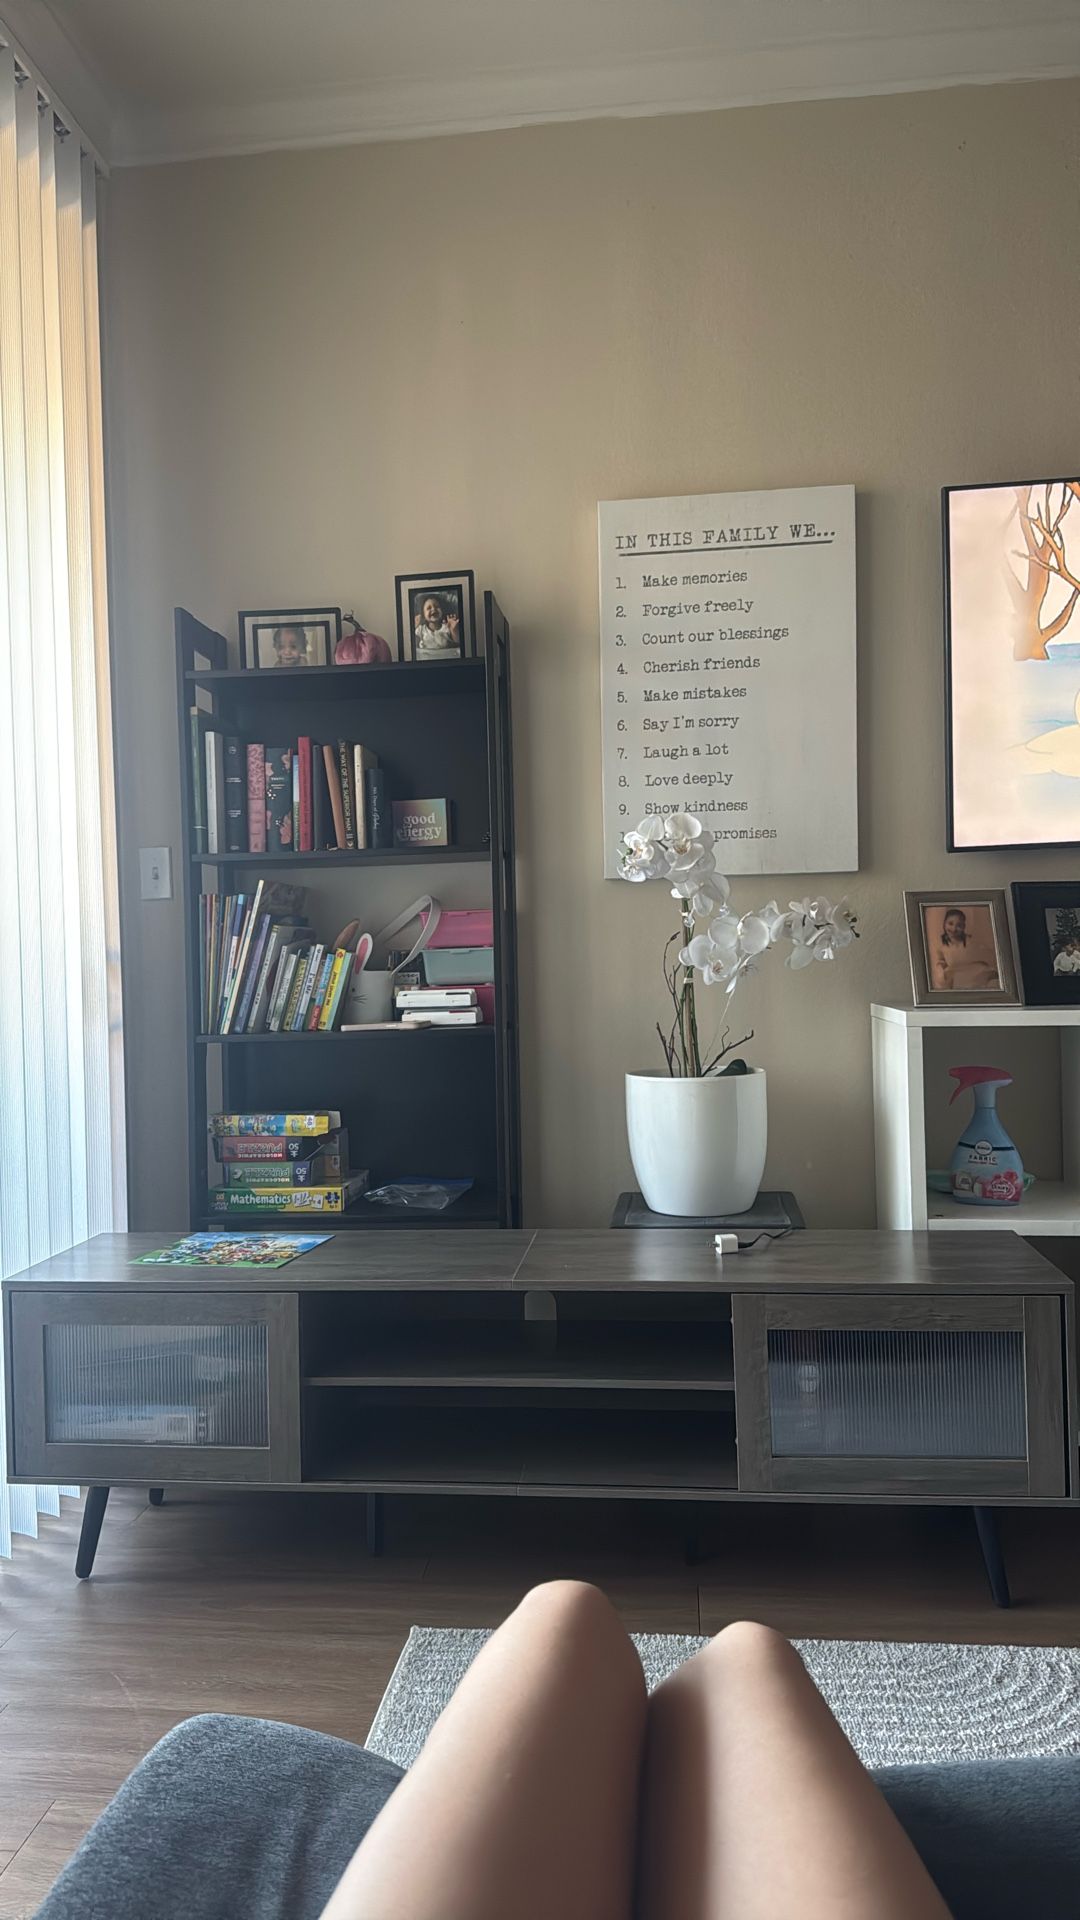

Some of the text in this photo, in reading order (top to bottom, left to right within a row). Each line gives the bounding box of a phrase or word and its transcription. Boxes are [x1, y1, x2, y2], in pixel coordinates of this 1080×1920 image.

[616, 524, 835, 549] IN THIS FAMILY WE...
[616, 570, 747, 589] 1. Make memories
[616, 599, 754, 618] 2. Forgive freely
[616, 627, 789, 646] 3. Count our blessings
[617, 656, 760, 674] 4. Cherish friends
[617, 687, 746, 703] 5. Make mistakes
[617, 716, 739, 732] 6. Say I'm sorry
[617, 744, 728, 760] 7. Laugh a lot
[619, 772, 733, 787] 8. Love deeply
[343, 789, 351, 817] SUPERIOR
[619, 800, 748, 815] 9. Show kindness
[403, 812, 436, 828] good
[397, 826, 442, 840] energy
[713, 828, 777, 842] promises
[230, 1193, 291, 1205] Mathematics
